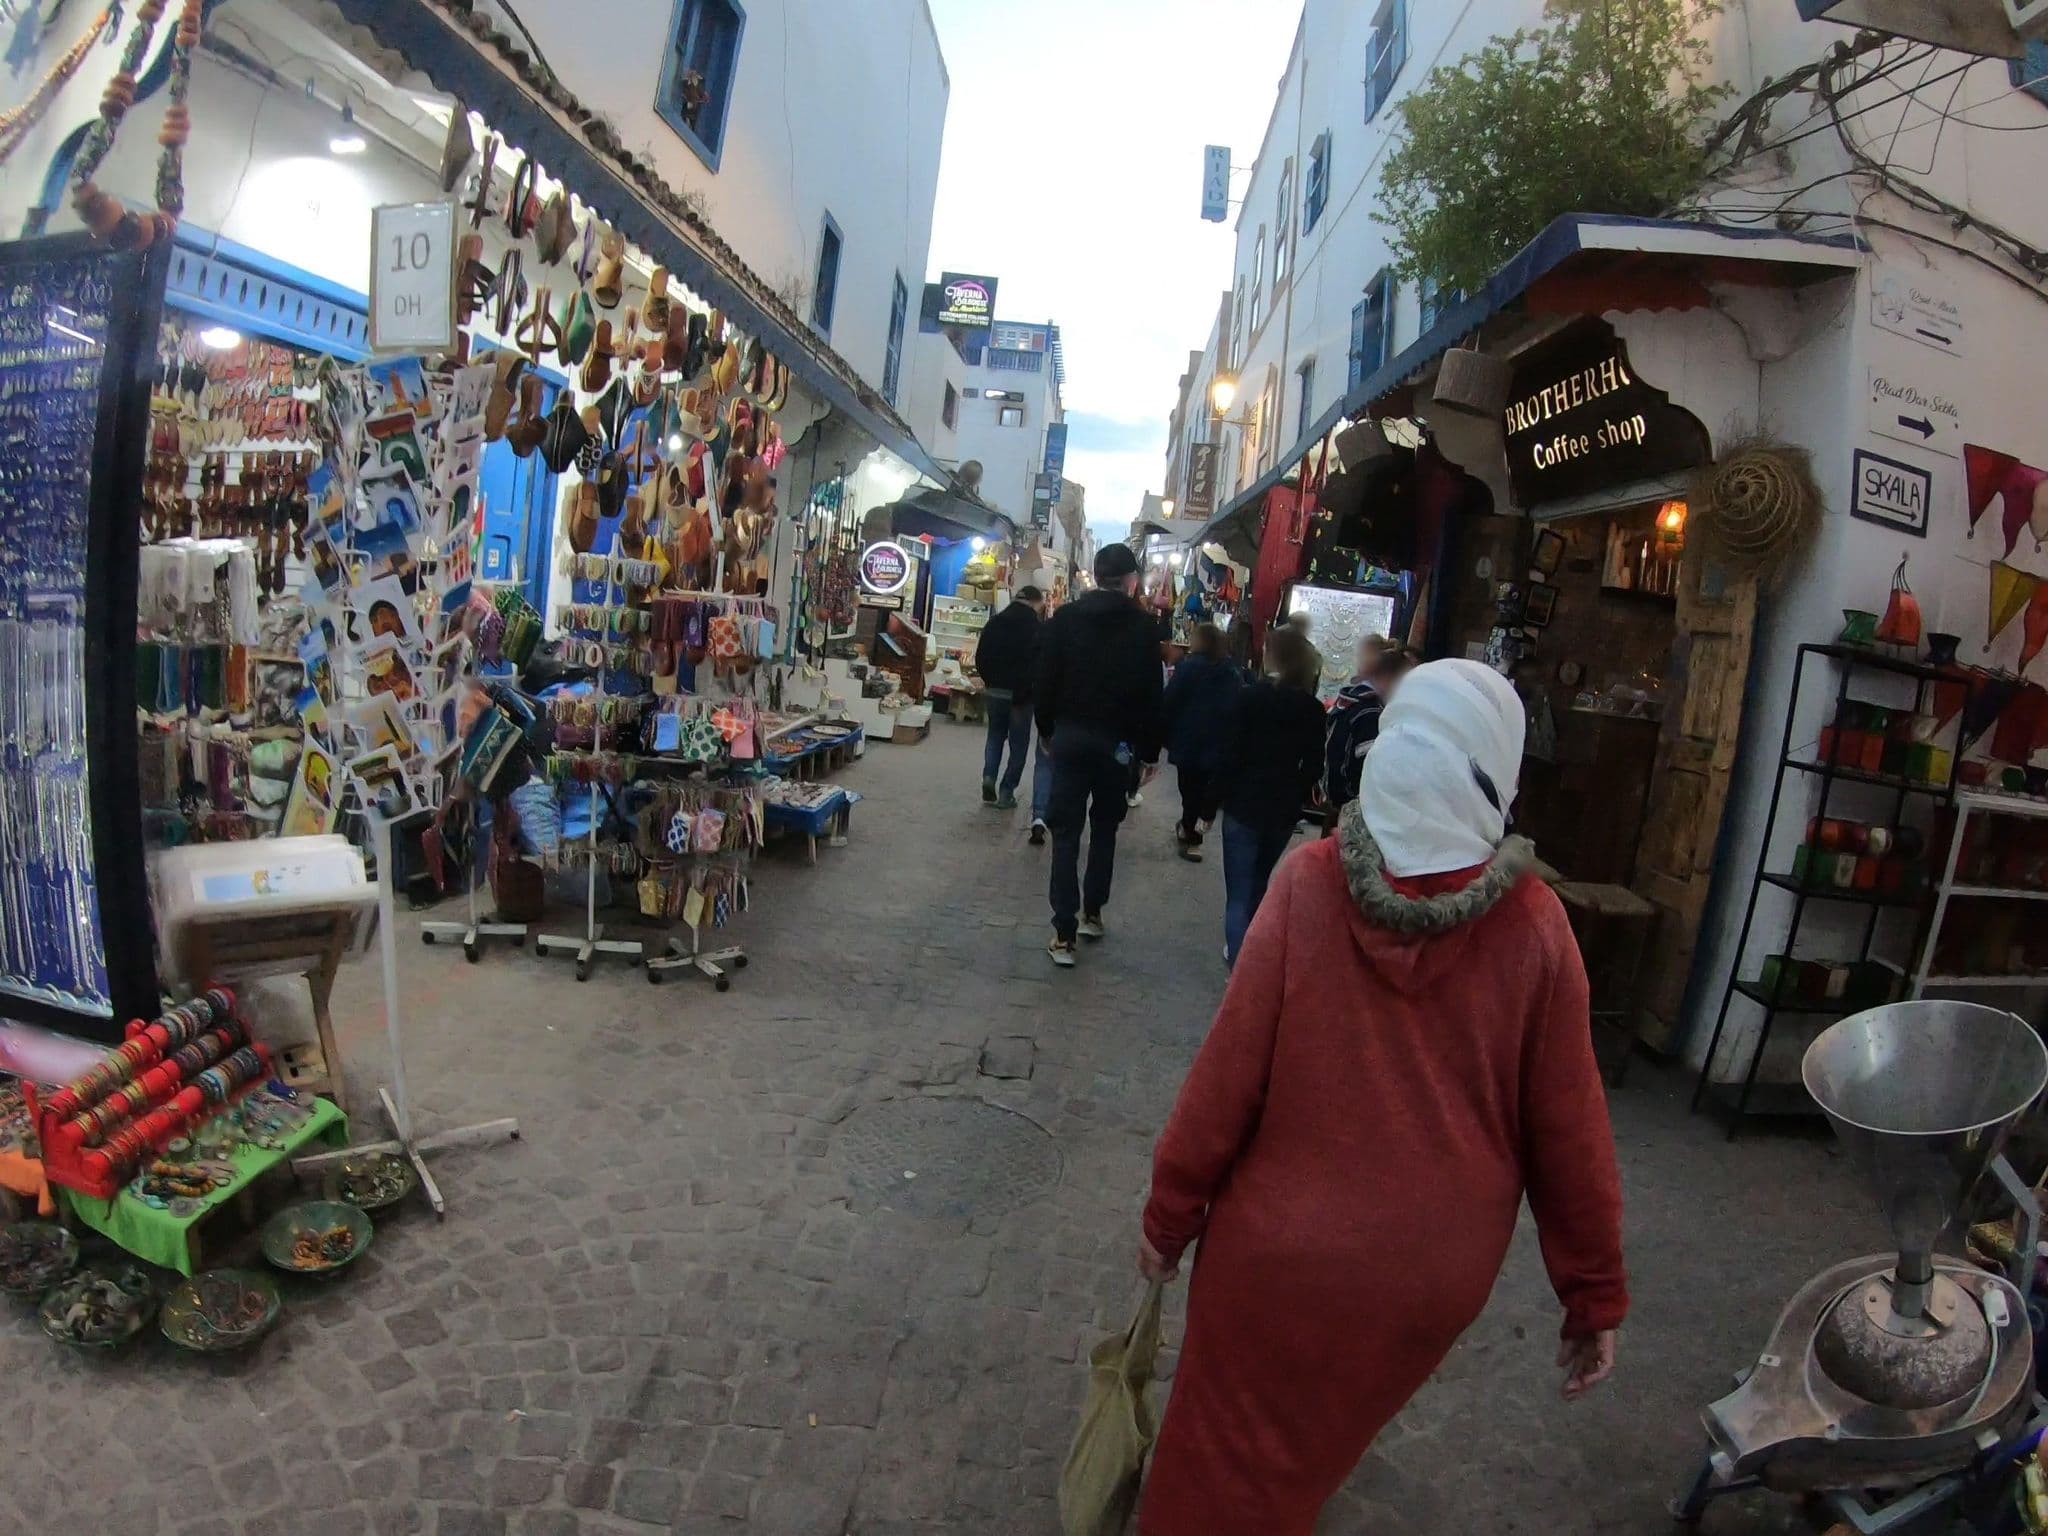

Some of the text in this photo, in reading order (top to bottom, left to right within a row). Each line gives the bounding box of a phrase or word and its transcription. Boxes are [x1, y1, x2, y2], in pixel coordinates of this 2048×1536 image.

[391, 232, 431, 272] 10
[394, 294, 421, 317] DH
[1873, 377, 1904, 398] Riad
[1905, 387, 1928, 406] Dar
[1533, 414, 1646, 470] Coffee shop
[1865, 468, 1921, 511] SKALA
